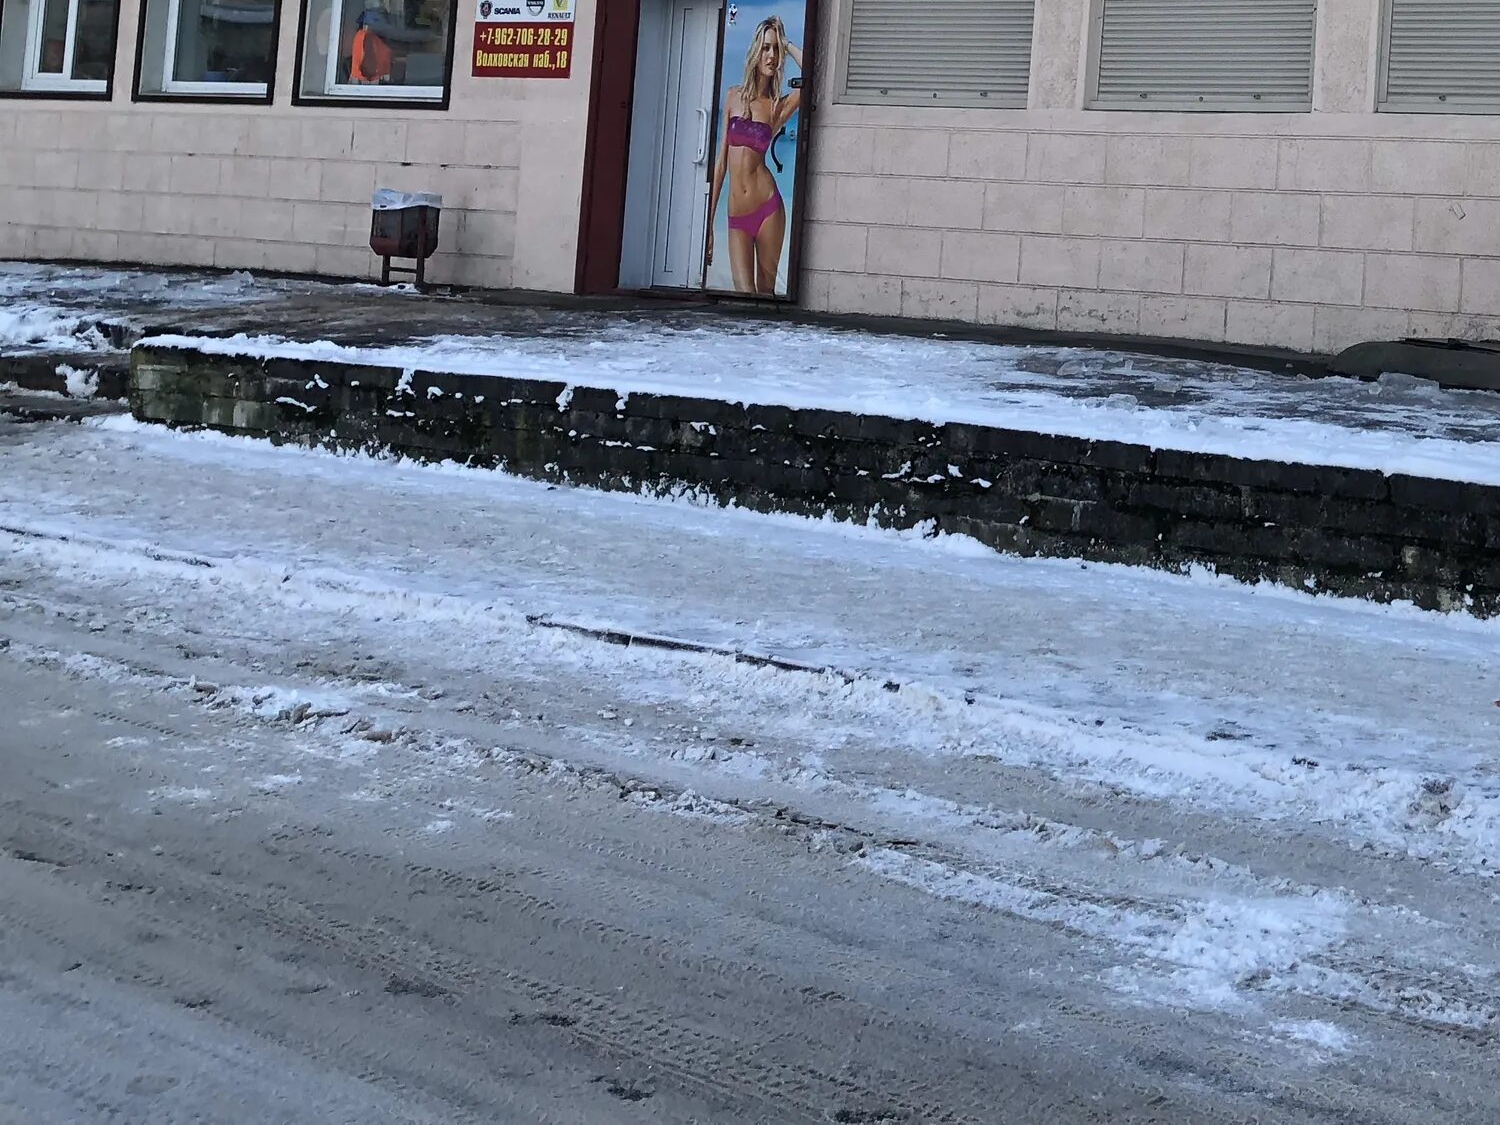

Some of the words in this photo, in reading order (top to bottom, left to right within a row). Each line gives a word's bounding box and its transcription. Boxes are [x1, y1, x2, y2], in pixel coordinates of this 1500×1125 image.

[494, 7, 521, 15] SCANIA
[480, 27, 568, 46] +7-962-706-28-29
[476, 50, 529, 67] Волховская
